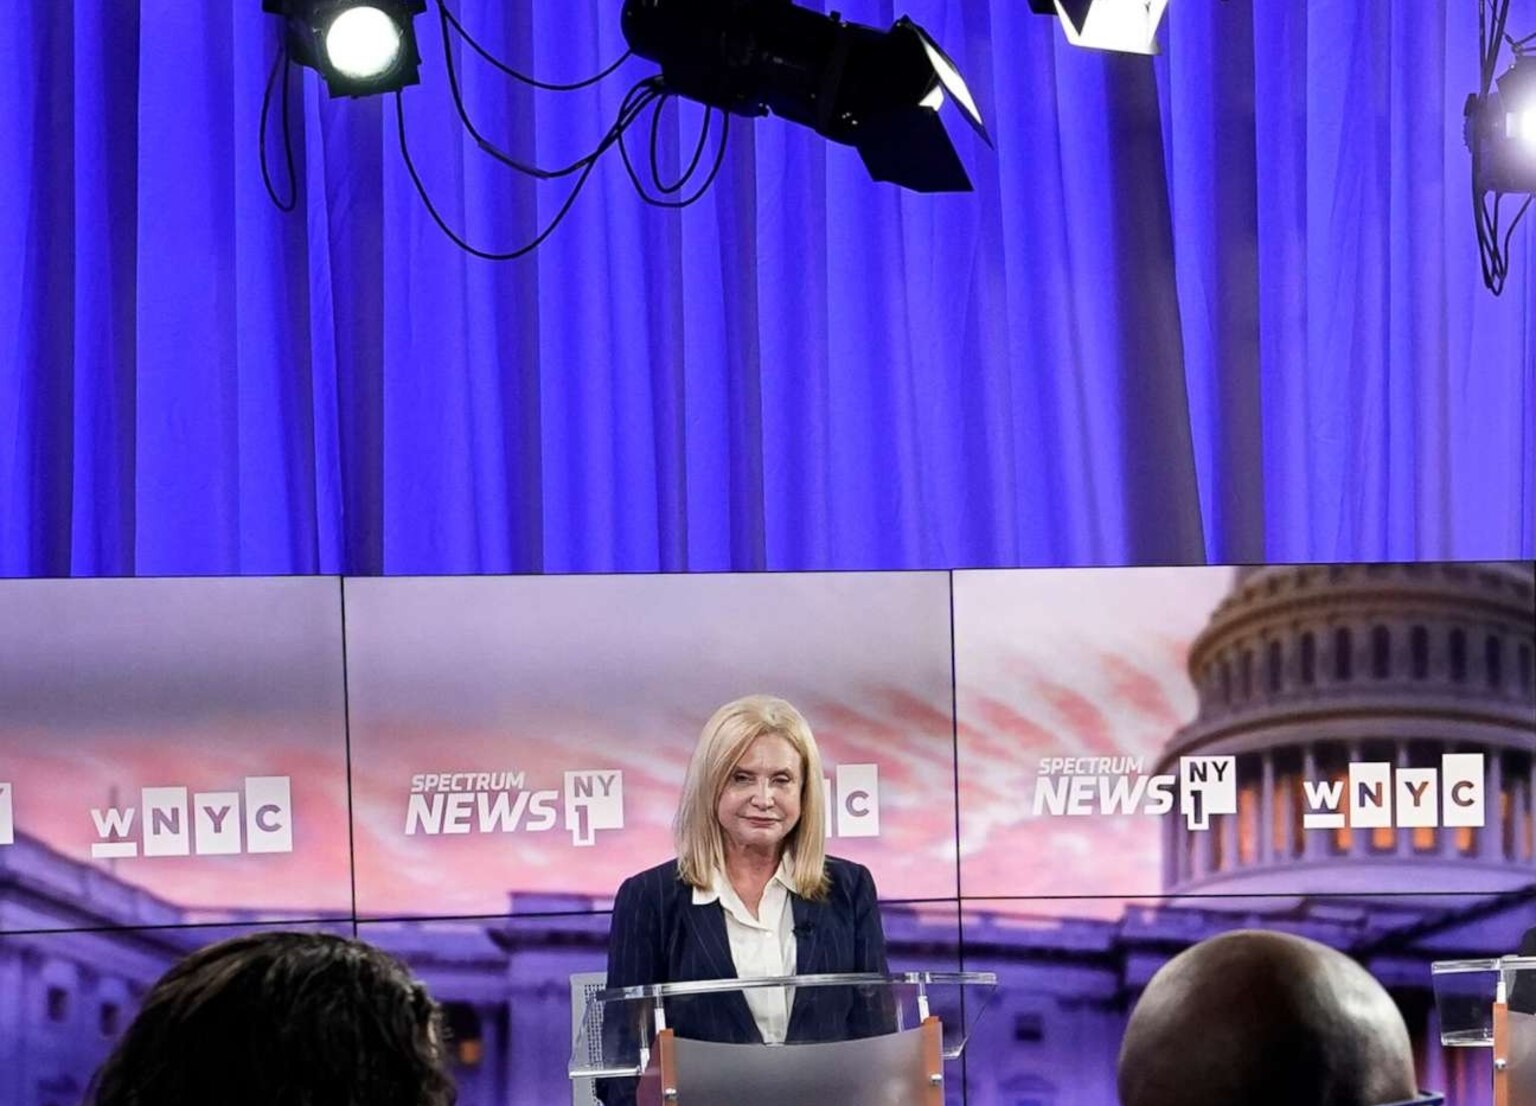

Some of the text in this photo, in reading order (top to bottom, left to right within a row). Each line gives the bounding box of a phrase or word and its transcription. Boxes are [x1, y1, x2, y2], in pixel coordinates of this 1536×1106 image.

[1038, 756, 1144, 774] SPECTRUM
[1189, 761, 1229, 783] NY
[411, 772, 525, 793] SPECTRUM
[574, 774, 616, 798] NY
[1032, 775, 1175, 815] NEWS
[405, 791, 557, 834] NEWS
